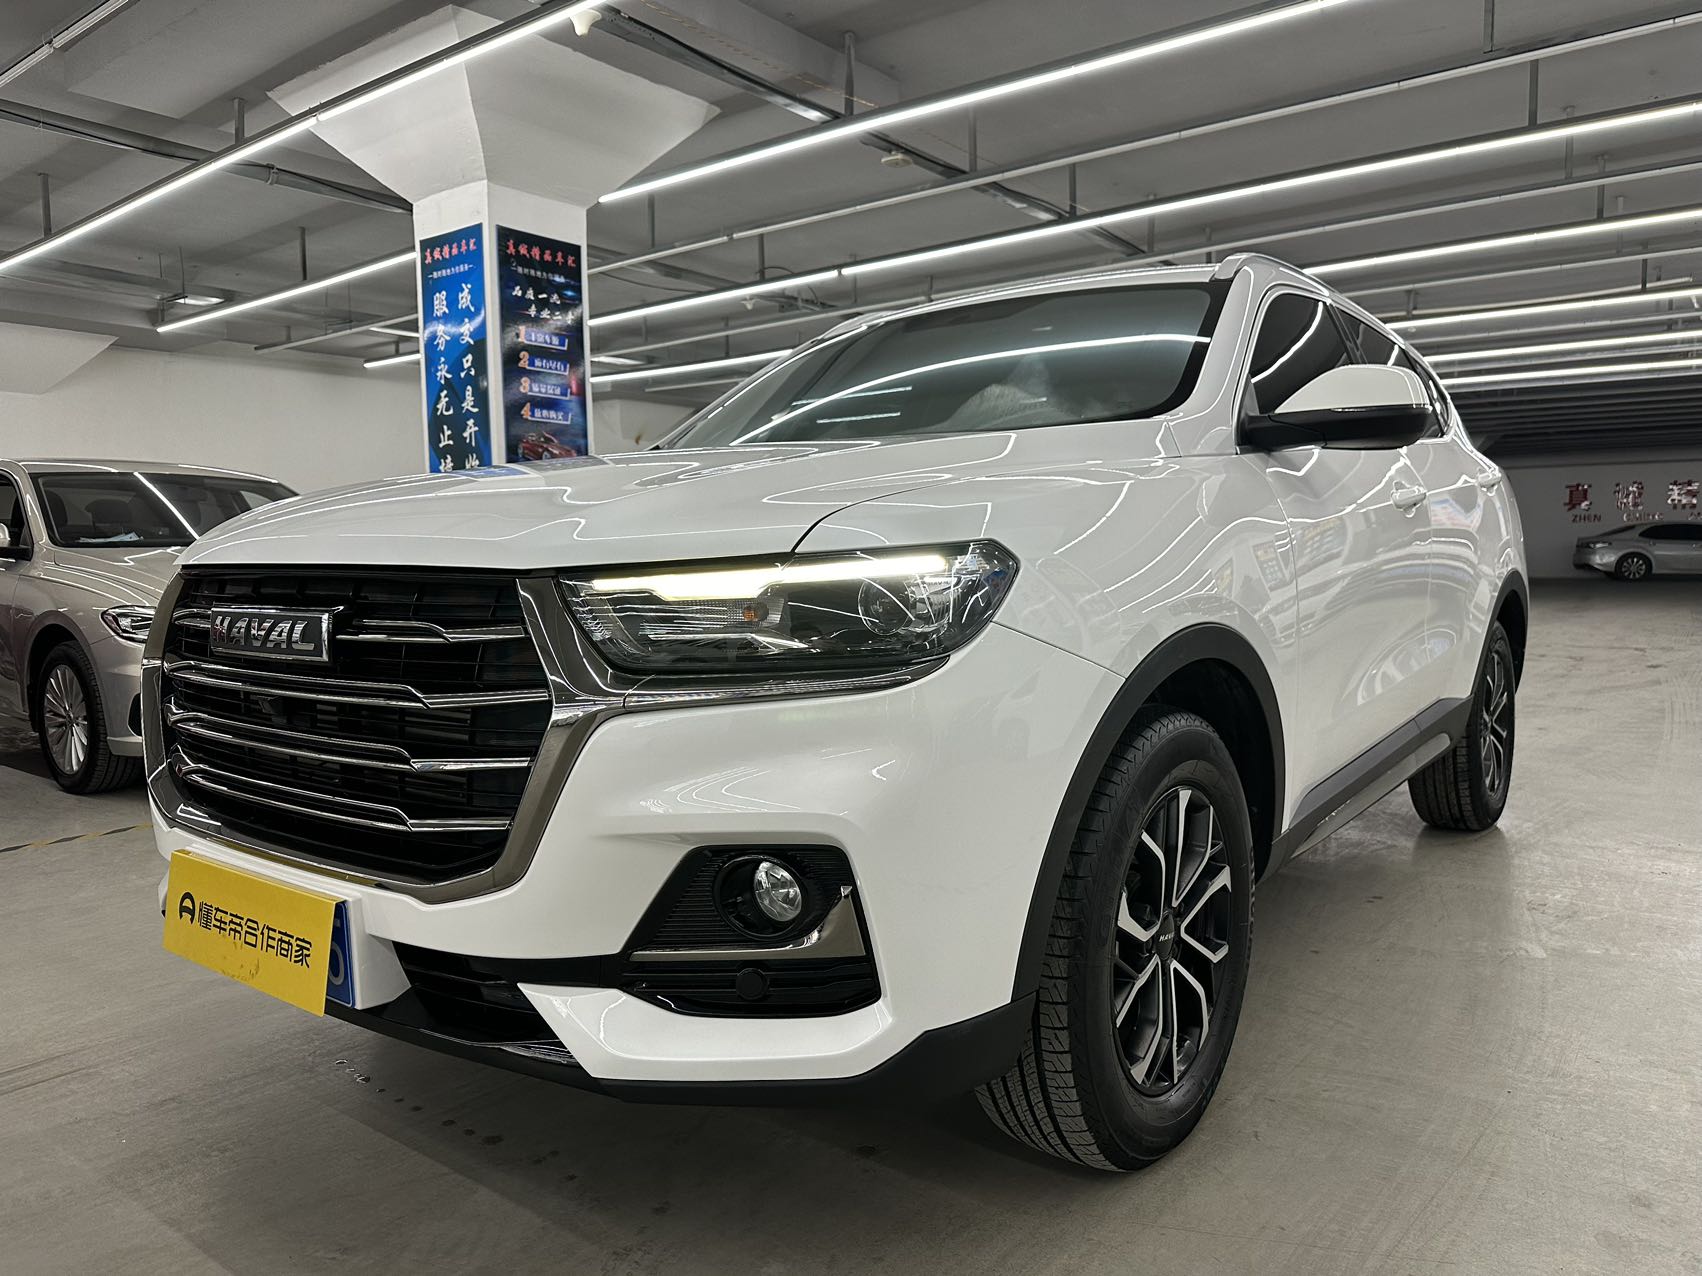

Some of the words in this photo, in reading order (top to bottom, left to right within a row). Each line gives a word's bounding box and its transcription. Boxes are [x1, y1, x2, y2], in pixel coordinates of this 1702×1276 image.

[1571, 513, 1602, 523] ZHEN
[213, 615, 315, 651] HAVAL
[197, 900, 313, 969] 懂车帝合作商家
